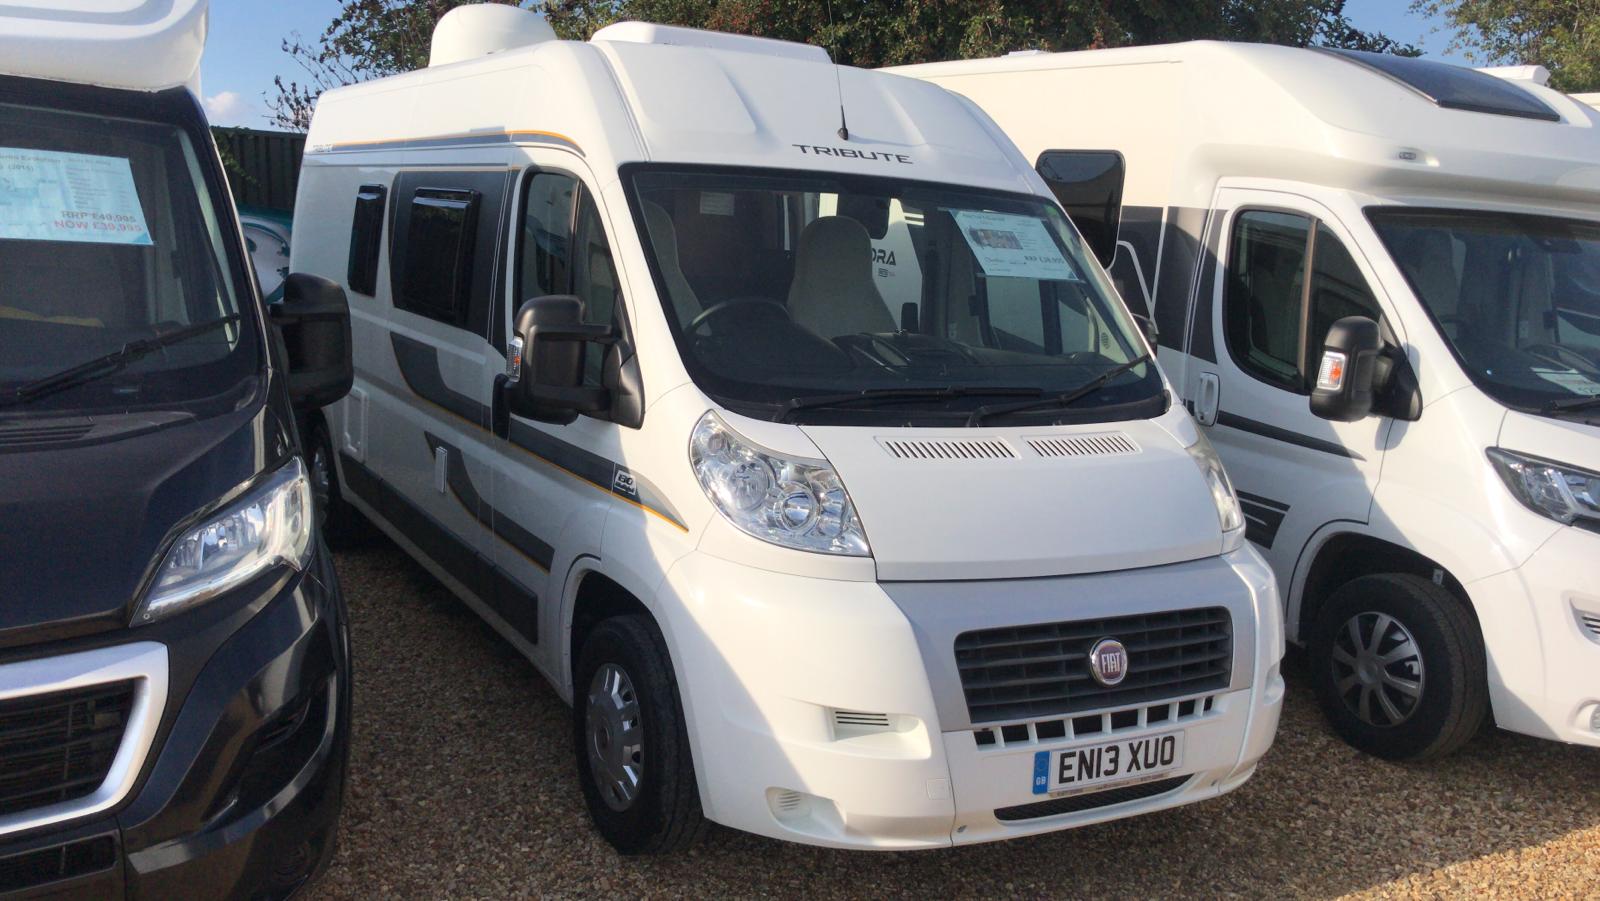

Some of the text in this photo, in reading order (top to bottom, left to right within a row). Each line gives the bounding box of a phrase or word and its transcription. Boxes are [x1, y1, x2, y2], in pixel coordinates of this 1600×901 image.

[792, 144, 914, 164] TRIBUTE
[54, 220, 88, 229] NOW
[1101, 652, 1121, 673] FIAT
[1058, 735, 1176, 784] EN13 XUO
[1035, 776, 1046, 785] GB
